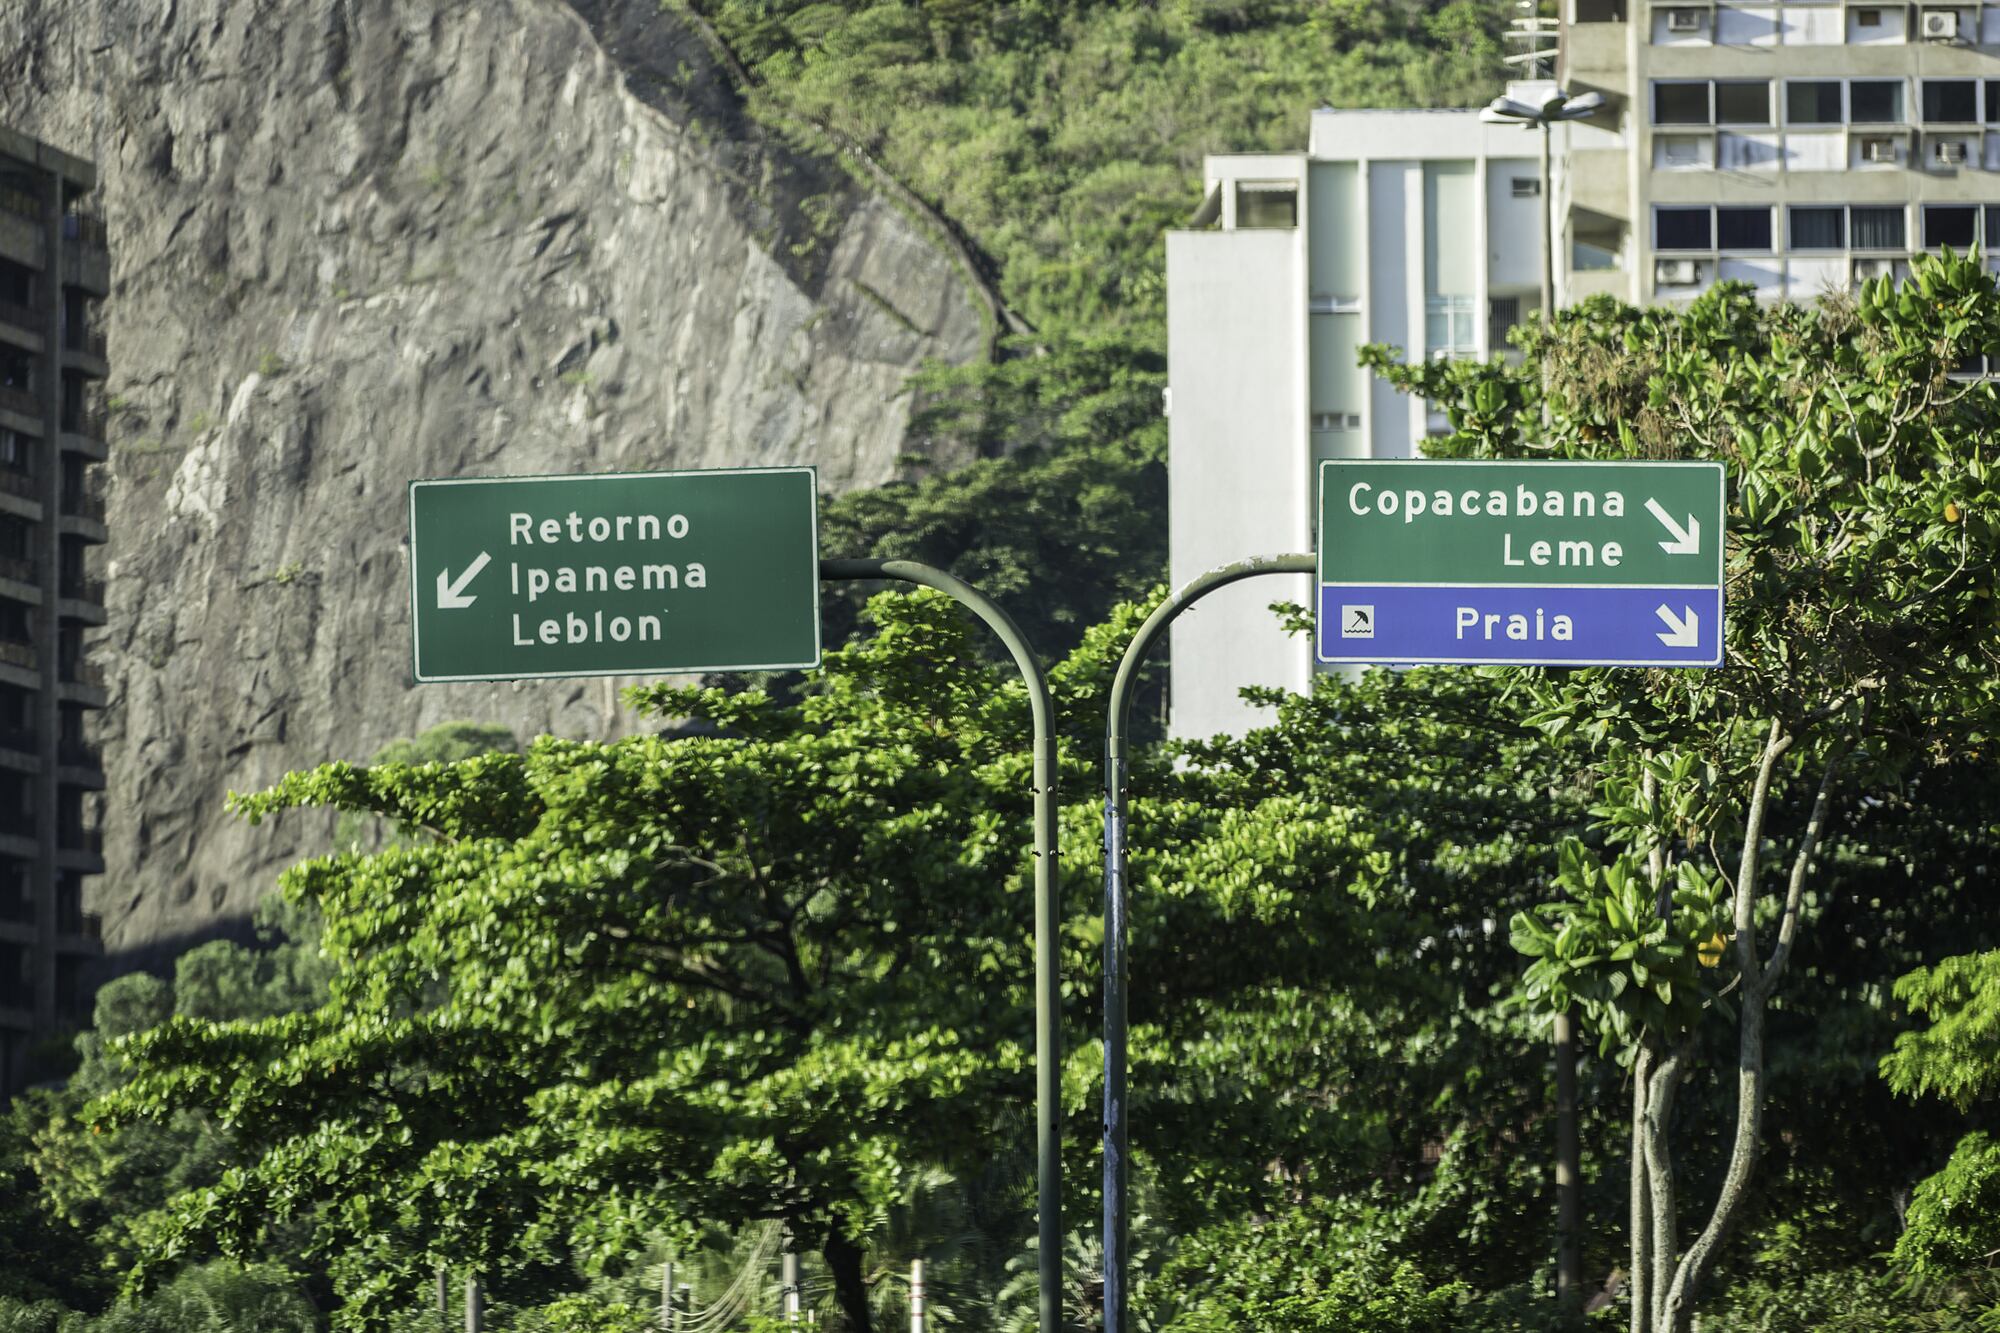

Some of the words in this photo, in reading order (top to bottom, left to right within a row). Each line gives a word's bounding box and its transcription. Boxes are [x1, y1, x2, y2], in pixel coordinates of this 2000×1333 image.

[1348, 482, 1624, 524] Copacabana
[510, 510, 689, 545] Retorno
[1504, 533, 1623, 566] Leme
[511, 562, 707, 602] Ipanema
[513, 610, 661, 645] Leblon
[1456, 607, 1573, 641] Praia
